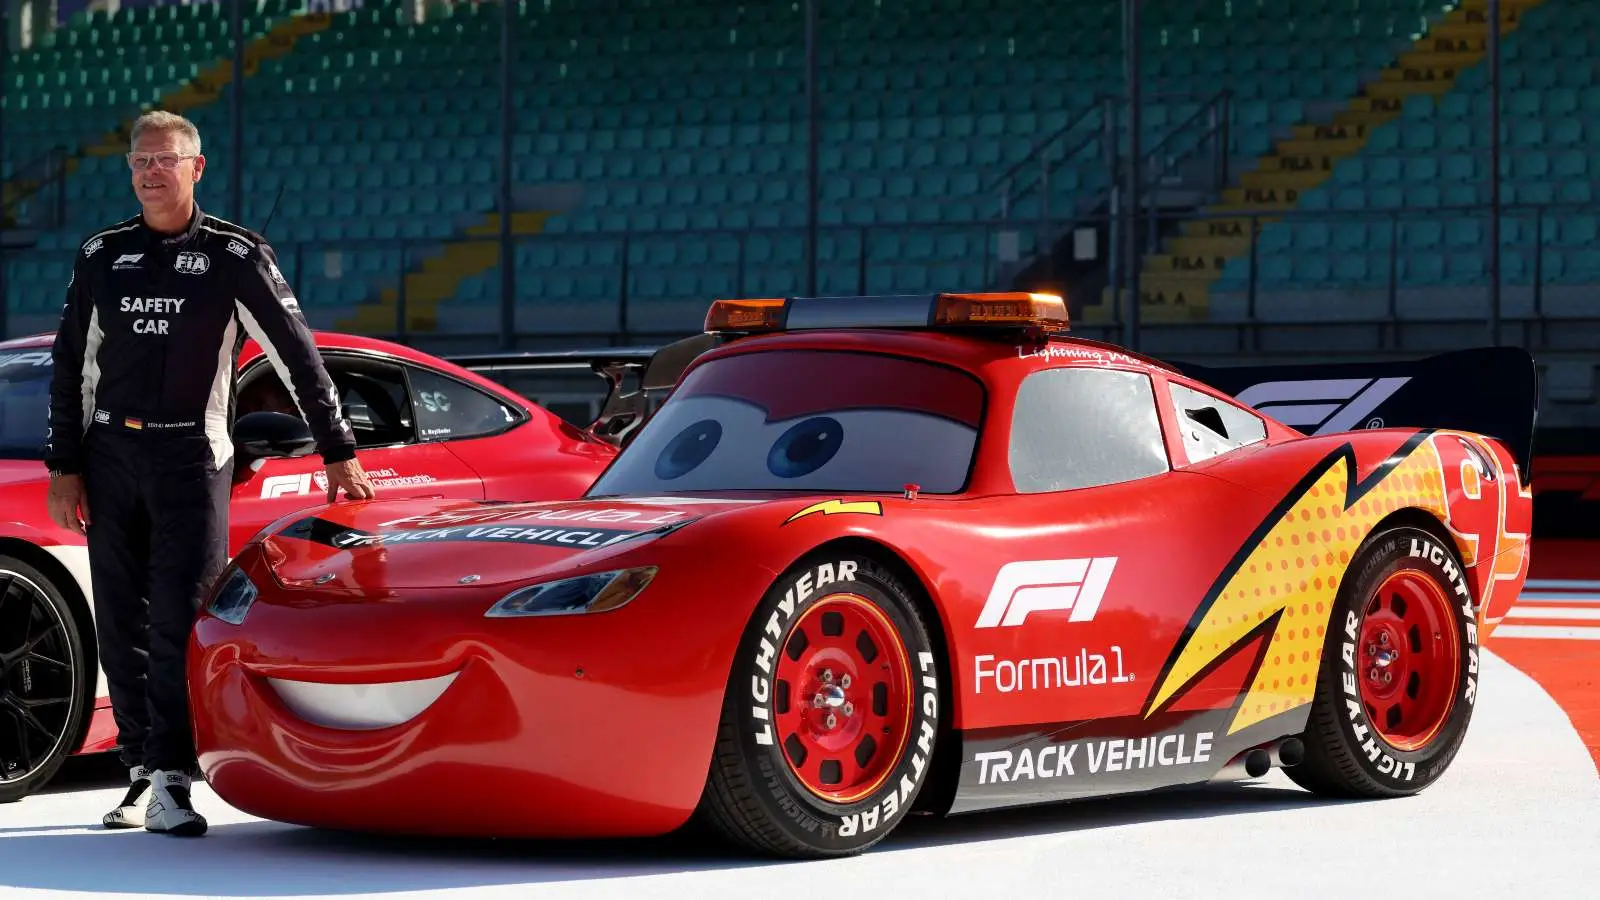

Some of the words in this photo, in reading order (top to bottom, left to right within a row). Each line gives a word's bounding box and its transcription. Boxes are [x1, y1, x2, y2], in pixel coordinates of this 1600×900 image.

[1280, 156, 1314, 171] FILA
[1244, 188, 1277, 203] FILA
[1209, 221, 1242, 236] FILA
[84, 239, 104, 255] OMP
[227, 241, 249, 256] OMP
[1172, 256, 1204, 270] FILA
[120, 297, 185, 314] SAFETY
[1173, 291, 1186, 305] A
[132, 319, 169, 335] CAR
[1016, 345, 1103, 366] Lightning
[420, 391, 451, 412] SC
[974, 556, 1119, 629] F1
[1408, 538, 1481, 706] LIGHTYEAR
[751, 560, 858, 746] LIGHTYEAR
[1342, 609, 1417, 782] LIGHTYEAR
[838, 651, 937, 838] LIGHTYEAR
[974, 743, 1079, 785] TRACK
[1086, 731, 1214, 775] VEHICLE
